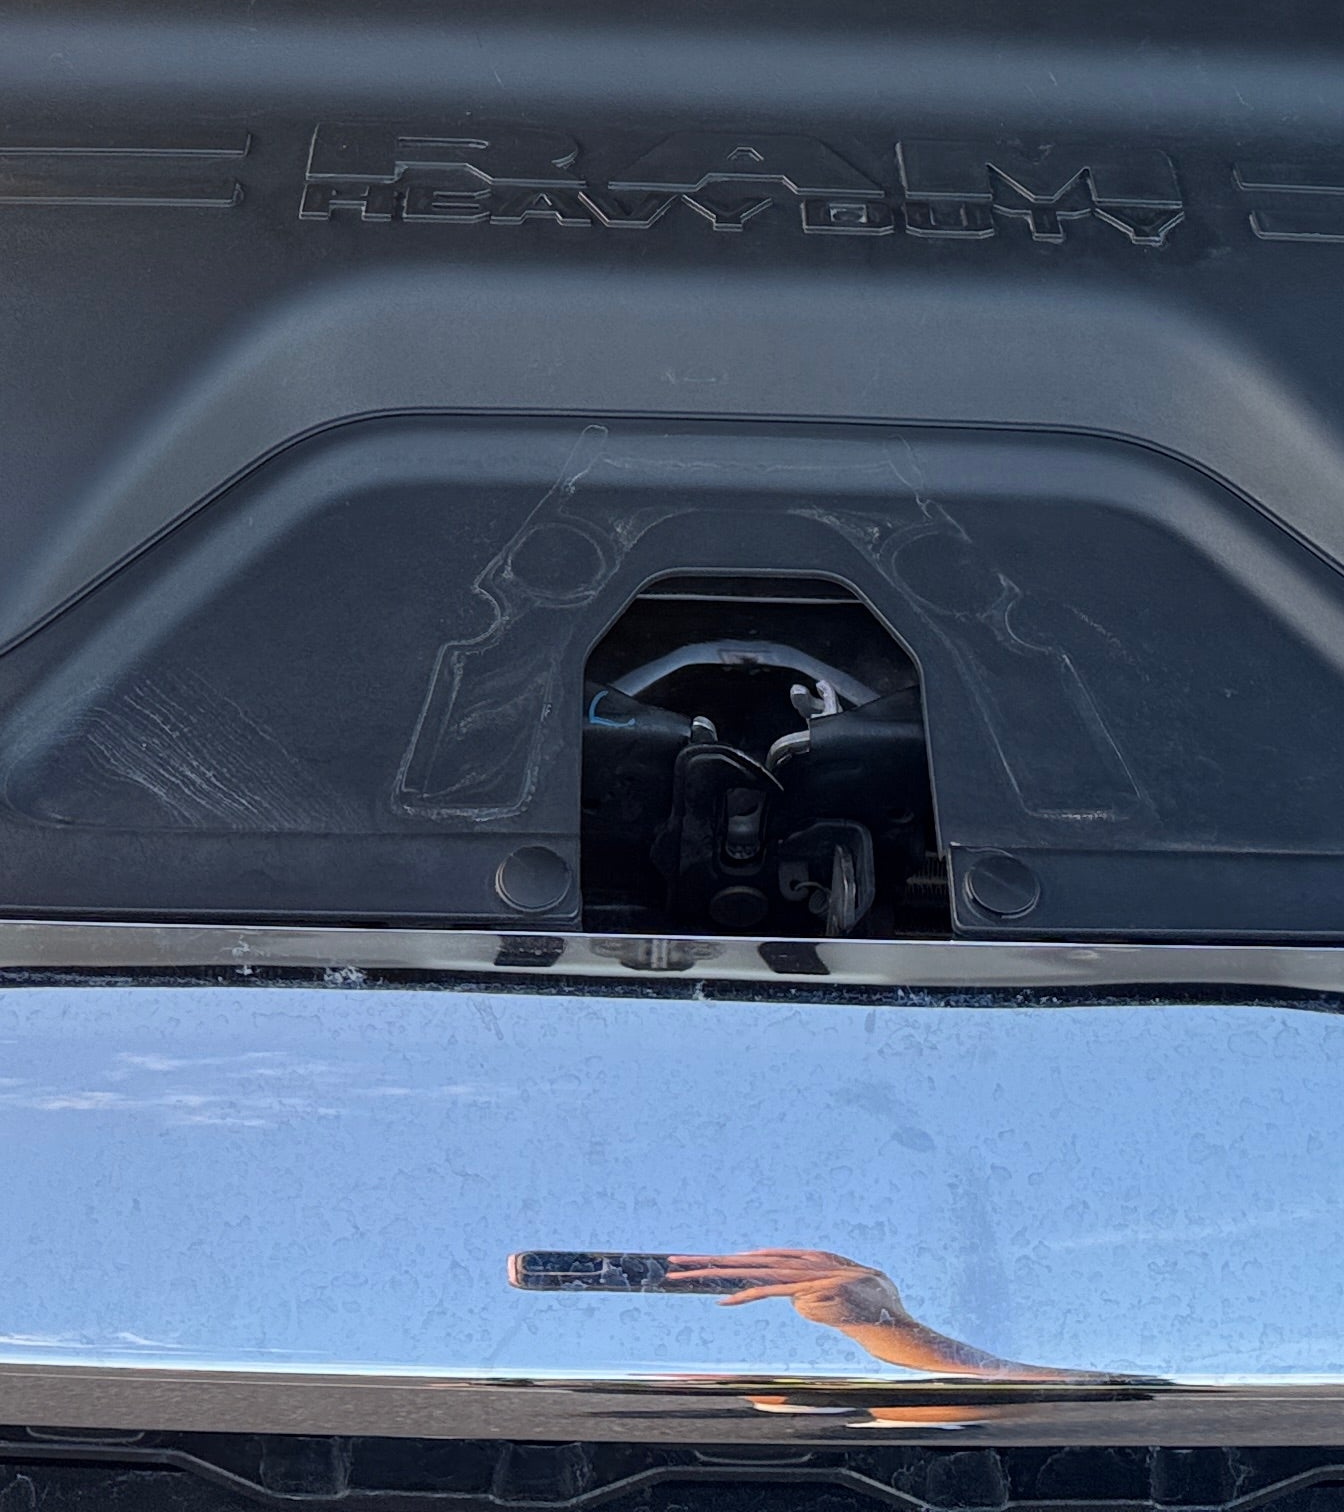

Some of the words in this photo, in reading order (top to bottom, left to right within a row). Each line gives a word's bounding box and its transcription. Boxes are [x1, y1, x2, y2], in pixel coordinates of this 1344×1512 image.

[304, 121, 1184, 209] RAM
[299, 183, 774, 232] HEAVY
[800, 197, 1185, 246] DUTY
